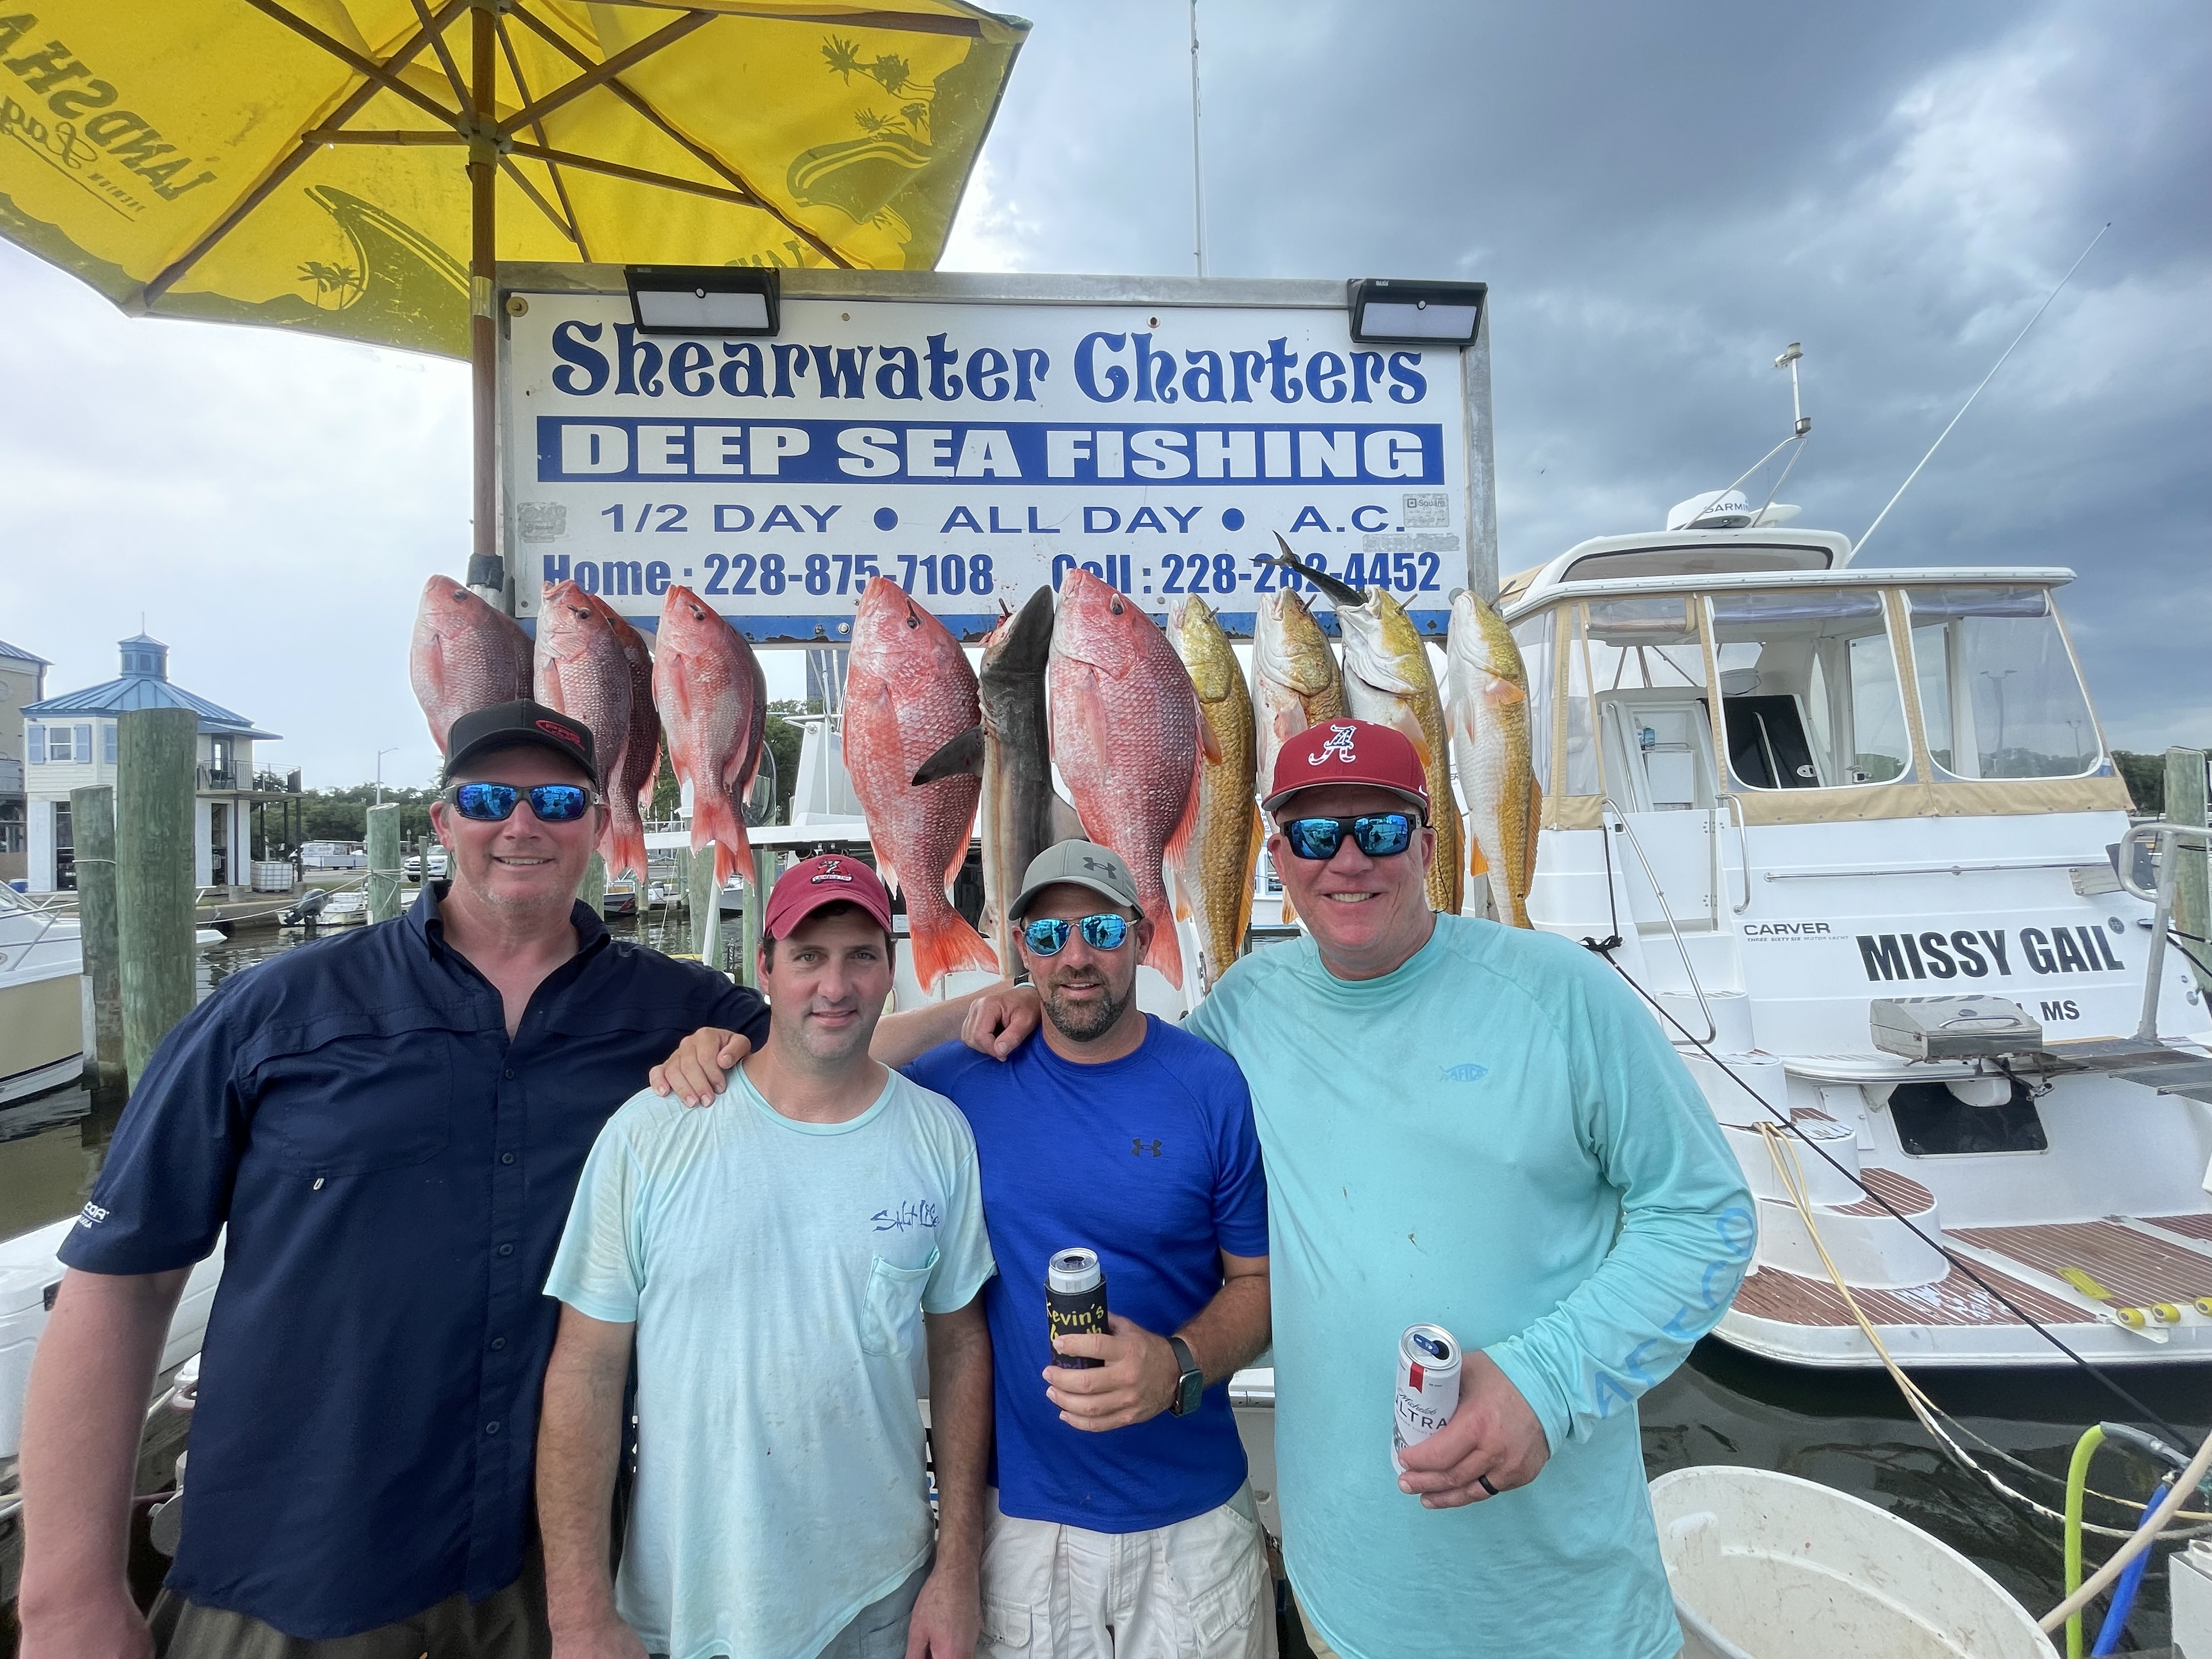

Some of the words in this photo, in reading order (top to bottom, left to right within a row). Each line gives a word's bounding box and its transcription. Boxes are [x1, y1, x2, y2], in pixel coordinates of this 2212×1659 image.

[551, 320, 1050, 402] Shearwater
[1074, 331, 1427, 404] Charters
[561, 424, 810, 476] DEEP
[837, 427, 1023, 477] SEA
[1046, 430, 1424, 479] FISHING
[602, 504, 688, 533] 1/2
[714, 504, 843, 533] DAY
[940, 506, 1061, 533] ALL
[1083, 506, 1203, 534] DAY
[1289, 505, 1405, 533] A.C.
[543, 555, 671, 595] Home
[704, 553, 994, 596] 228-875-7108
[1743, 923, 1831, 935] CARVER
[1855, 929, 2012, 981] MISSY
[2018, 925, 2126, 975] GAIL
[2040, 1000, 2080, 1021] MS
